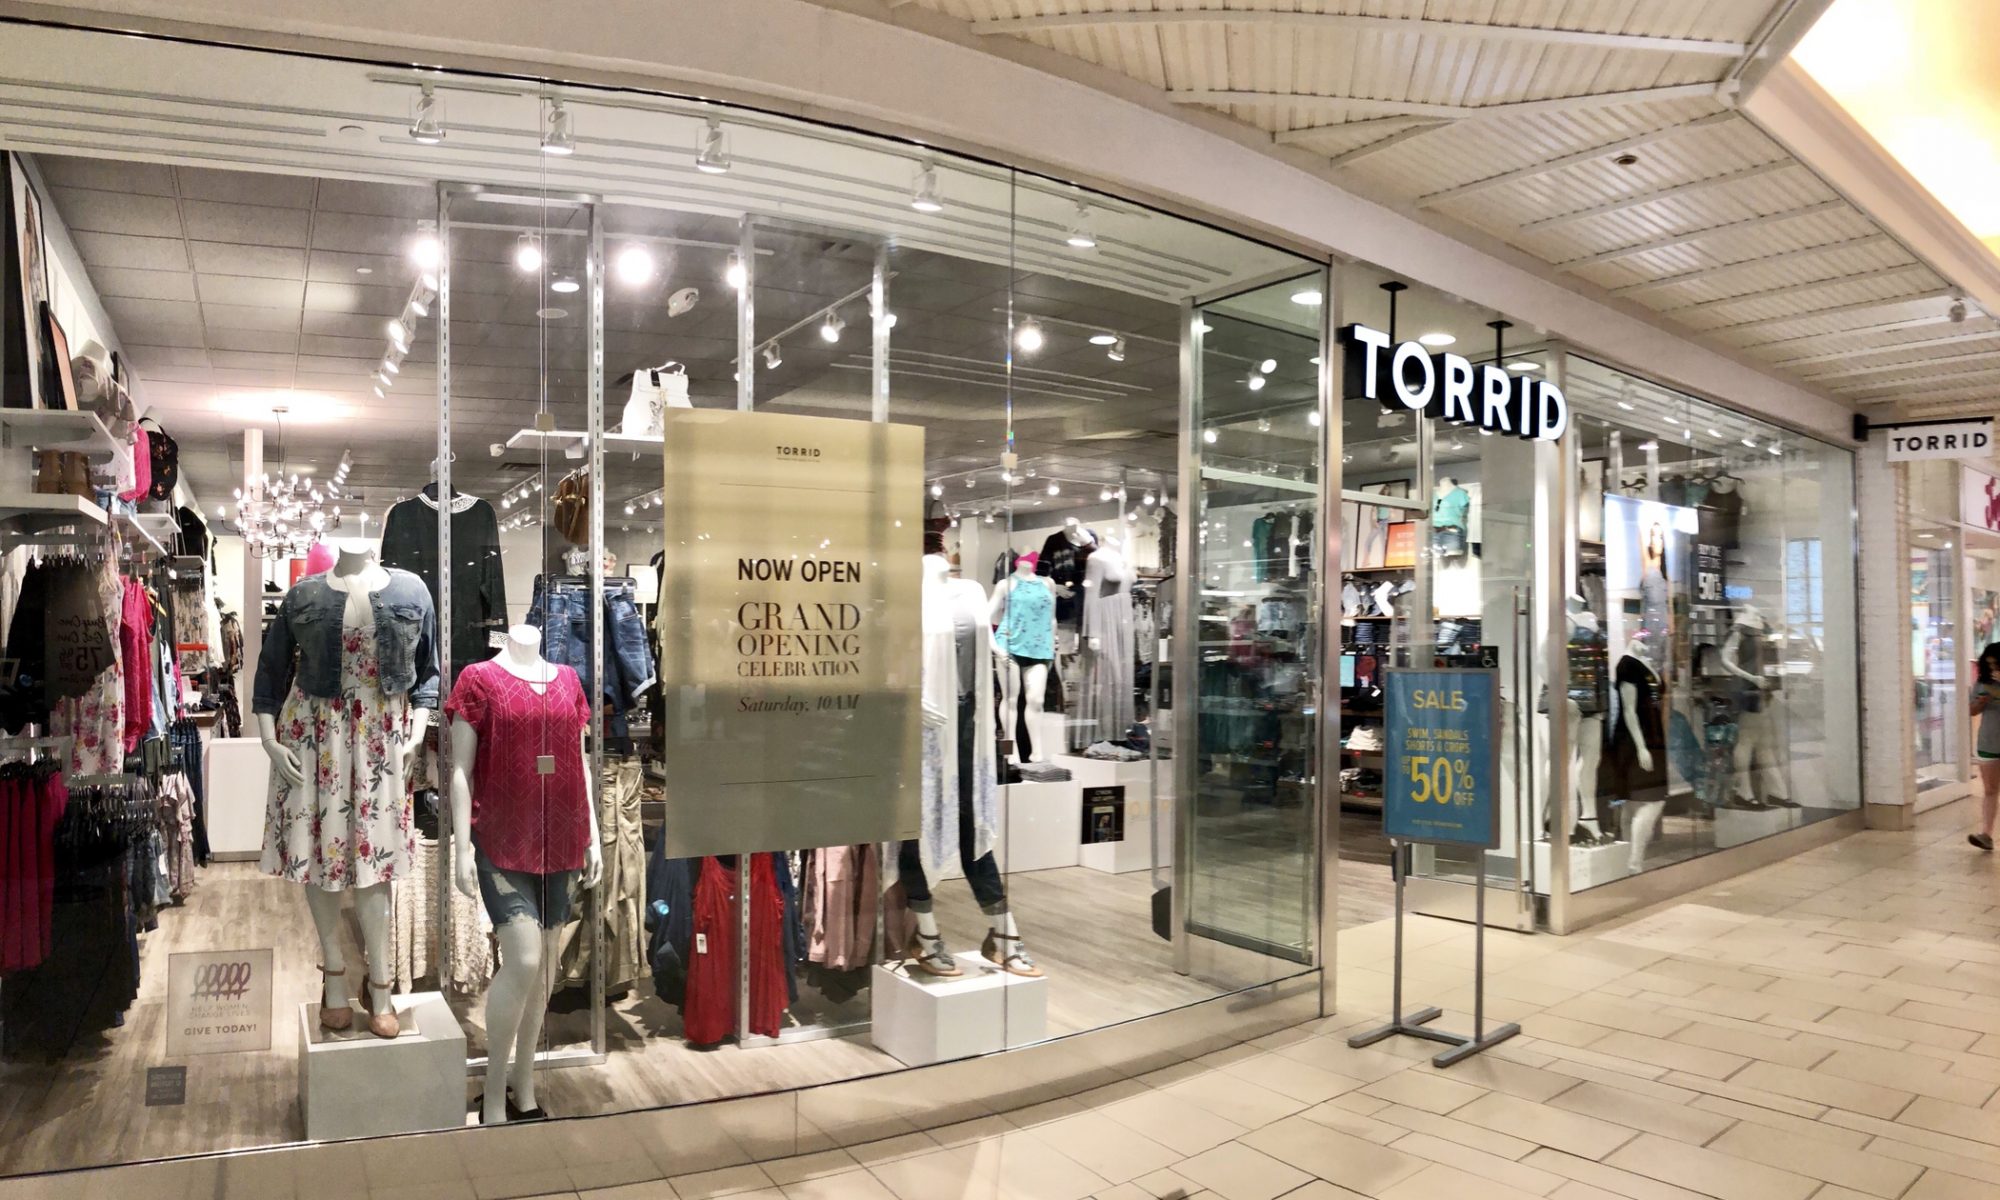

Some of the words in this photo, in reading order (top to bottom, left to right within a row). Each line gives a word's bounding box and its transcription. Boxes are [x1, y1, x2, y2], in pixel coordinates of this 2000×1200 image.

[1353, 324, 1568, 441] TORRID
[776, 445, 821, 458] TORRID
[1893, 432, 1988, 452] TORRID
[737, 557, 793, 582] NOW
[801, 559, 861, 583] OPEN
[737, 601, 861, 631] GRAND
[737, 634, 861, 657] OPENING
[737, 660, 861, 678] CELEBRATION
[1412, 689, 1463, 710] SALE
[1453, 791, 1475, 806] OFF
[184, 1026, 211, 1036] GIVE
[215, 1023, 257, 1034] TODAY!
